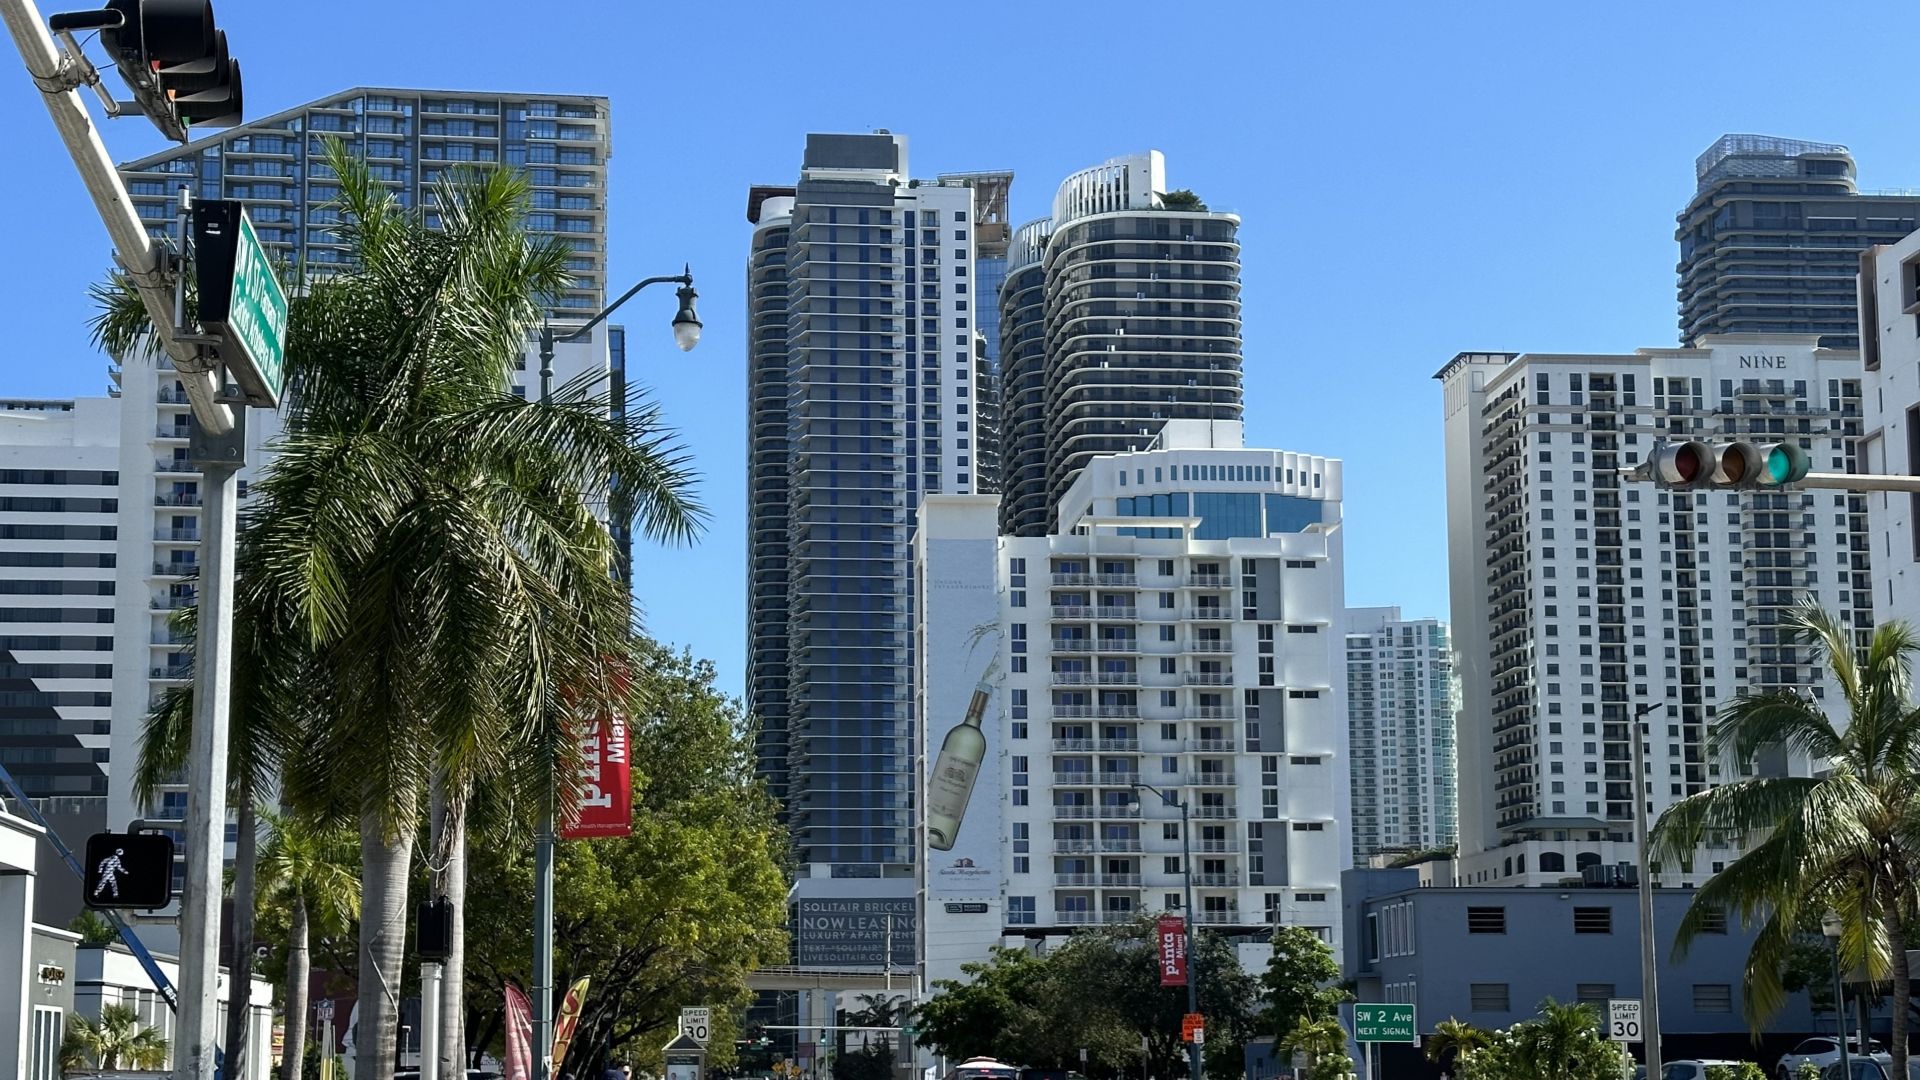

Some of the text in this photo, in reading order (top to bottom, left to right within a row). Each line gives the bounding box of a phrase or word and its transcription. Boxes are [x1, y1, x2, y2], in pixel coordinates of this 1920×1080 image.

[246, 242, 253, 295] 8
[1739, 355, 1787, 369] NINE
[570, 705, 611, 809] pint
[803, 902, 915, 912] SOLITAIR BRICKEL
[803, 917, 845, 930] NOW
[803, 931, 846, 940] LUXURY
[1175, 934, 1184, 959] Miami
[1162, 932, 1180, 976] pinta
[1611, 1003, 1639, 1011] SPEED
[1356, 1010, 1412, 1023] SW 2 Ave
[685, 1026, 707, 1039] 30
[1357, 1027, 1411, 1035] NEXT SIGNAL
[1613, 1021, 1639, 1037] 30
